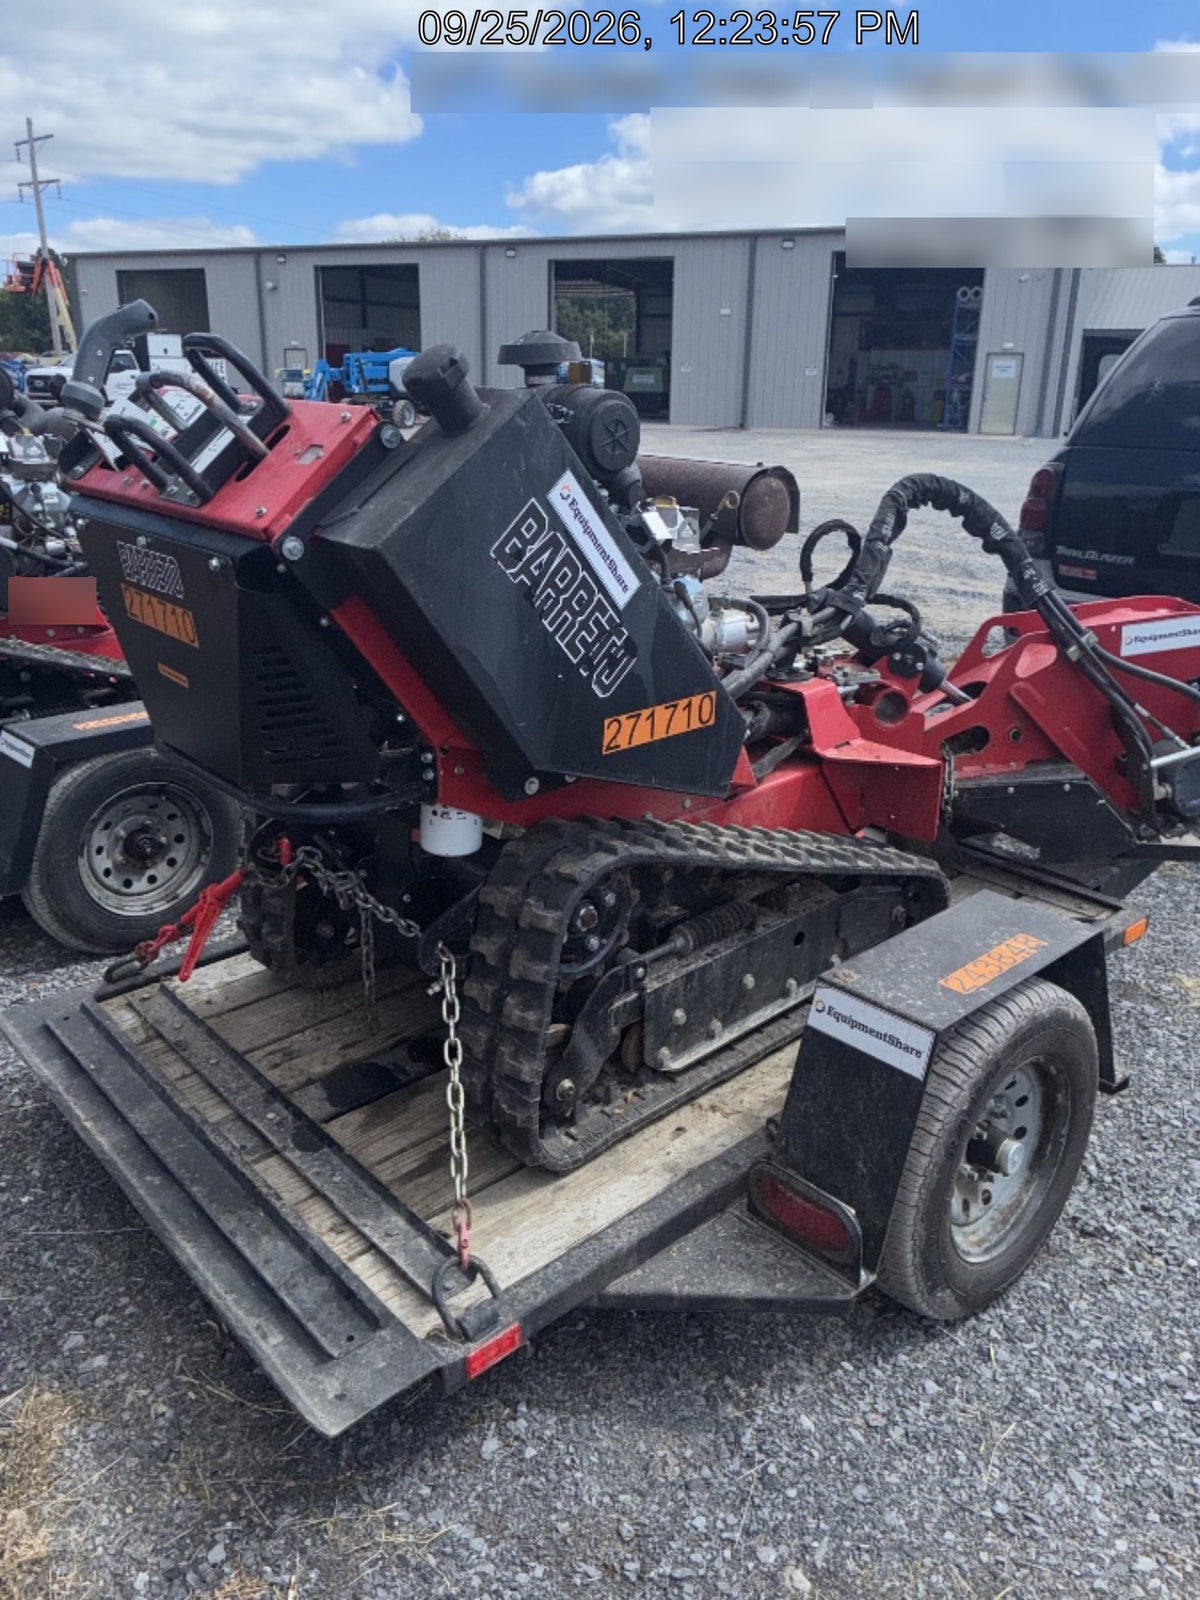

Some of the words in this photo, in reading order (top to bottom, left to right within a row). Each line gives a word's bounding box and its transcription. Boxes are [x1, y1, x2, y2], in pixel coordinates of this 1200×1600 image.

[568, 497, 629, 594] EquipmentShare
[122, 584, 199, 645] 271710
[604, 693, 715, 752] 271710
[826, 1004, 923, 1060] EquipmentShare
